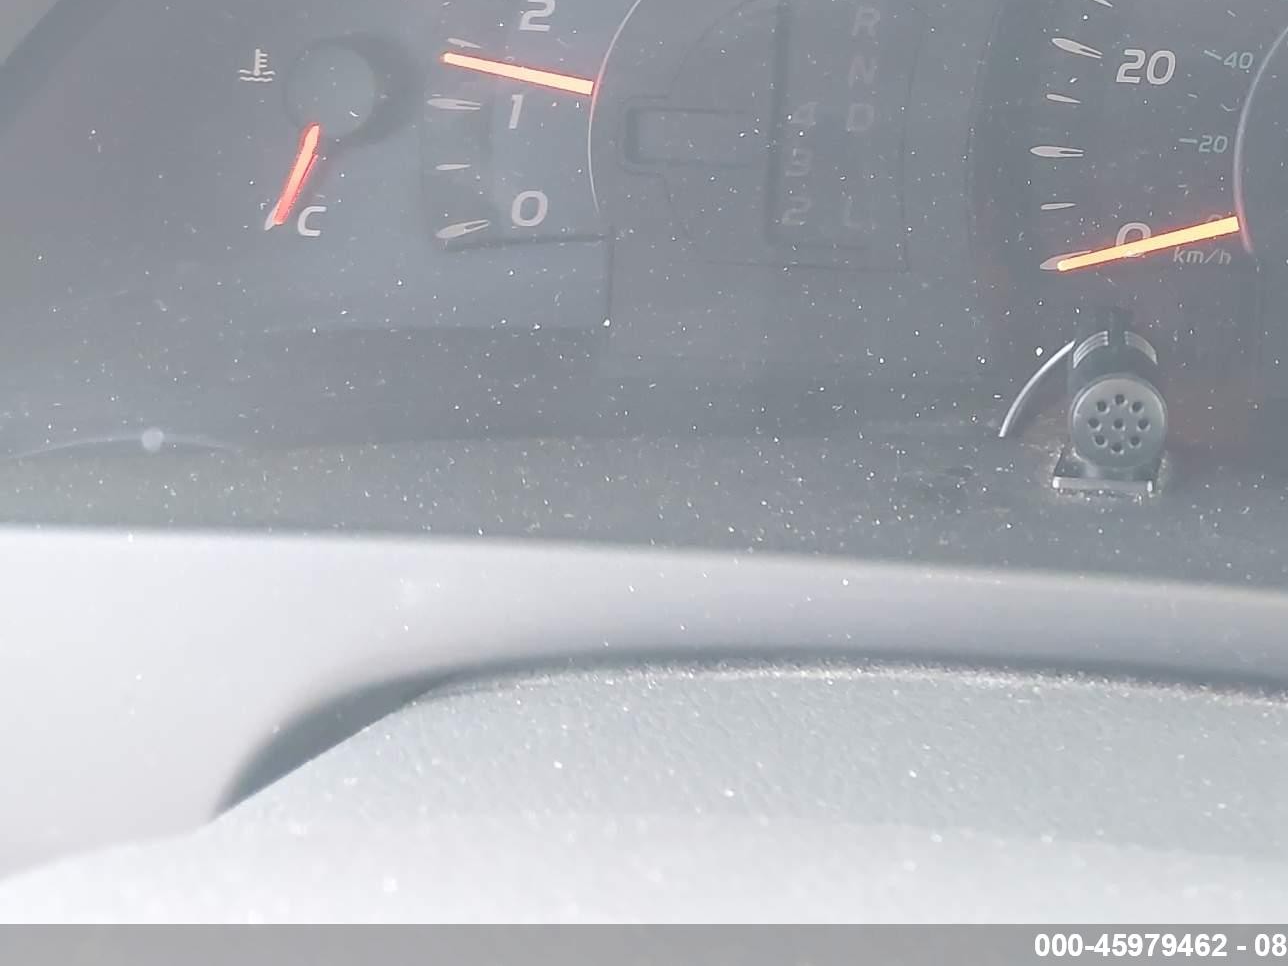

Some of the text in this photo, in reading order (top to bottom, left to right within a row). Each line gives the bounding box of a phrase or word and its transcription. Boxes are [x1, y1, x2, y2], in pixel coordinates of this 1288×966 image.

[850, 5, 881, 37] R
[1116, 49, 1176, 85] 20
[1223, 51, 1253, 71] 40
[509, 93, 524, 129] 1
[845, 103, 876, 133] D
[1198, 135, 1228, 153] 20
[297, 205, 327, 237] C
[511, 190, 548, 228] 0
[1172, 245, 1232, 265] km/h
